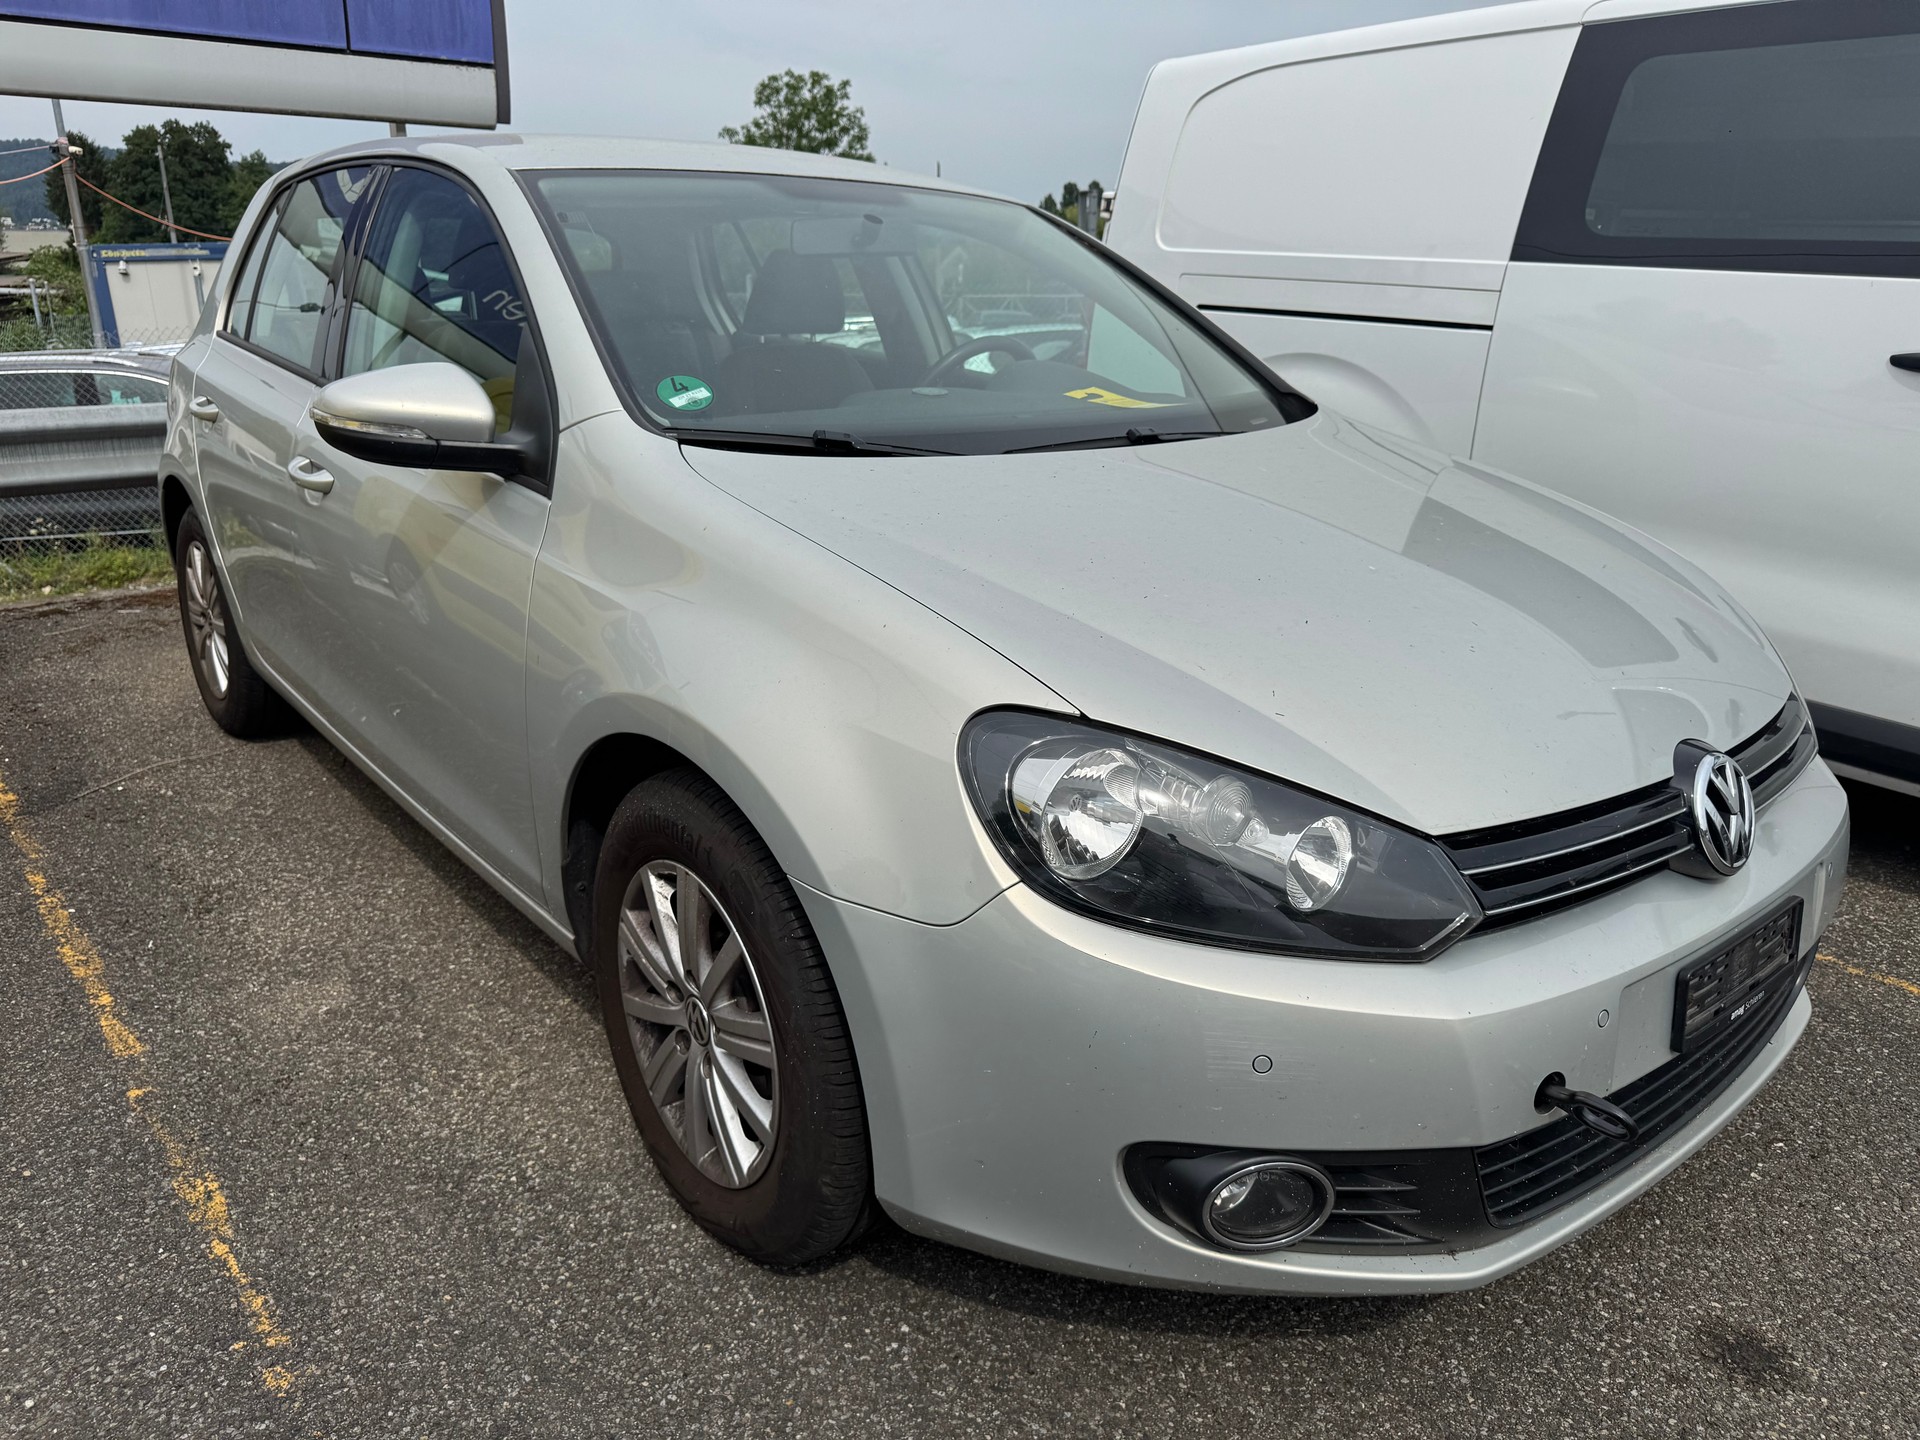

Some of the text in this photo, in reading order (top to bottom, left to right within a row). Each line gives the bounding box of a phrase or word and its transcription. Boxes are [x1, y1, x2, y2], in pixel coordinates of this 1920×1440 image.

[670, 377, 688, 391] 4
[1697, 755, 1753, 873] VW
[1730, 1004, 1745, 1020] amag
